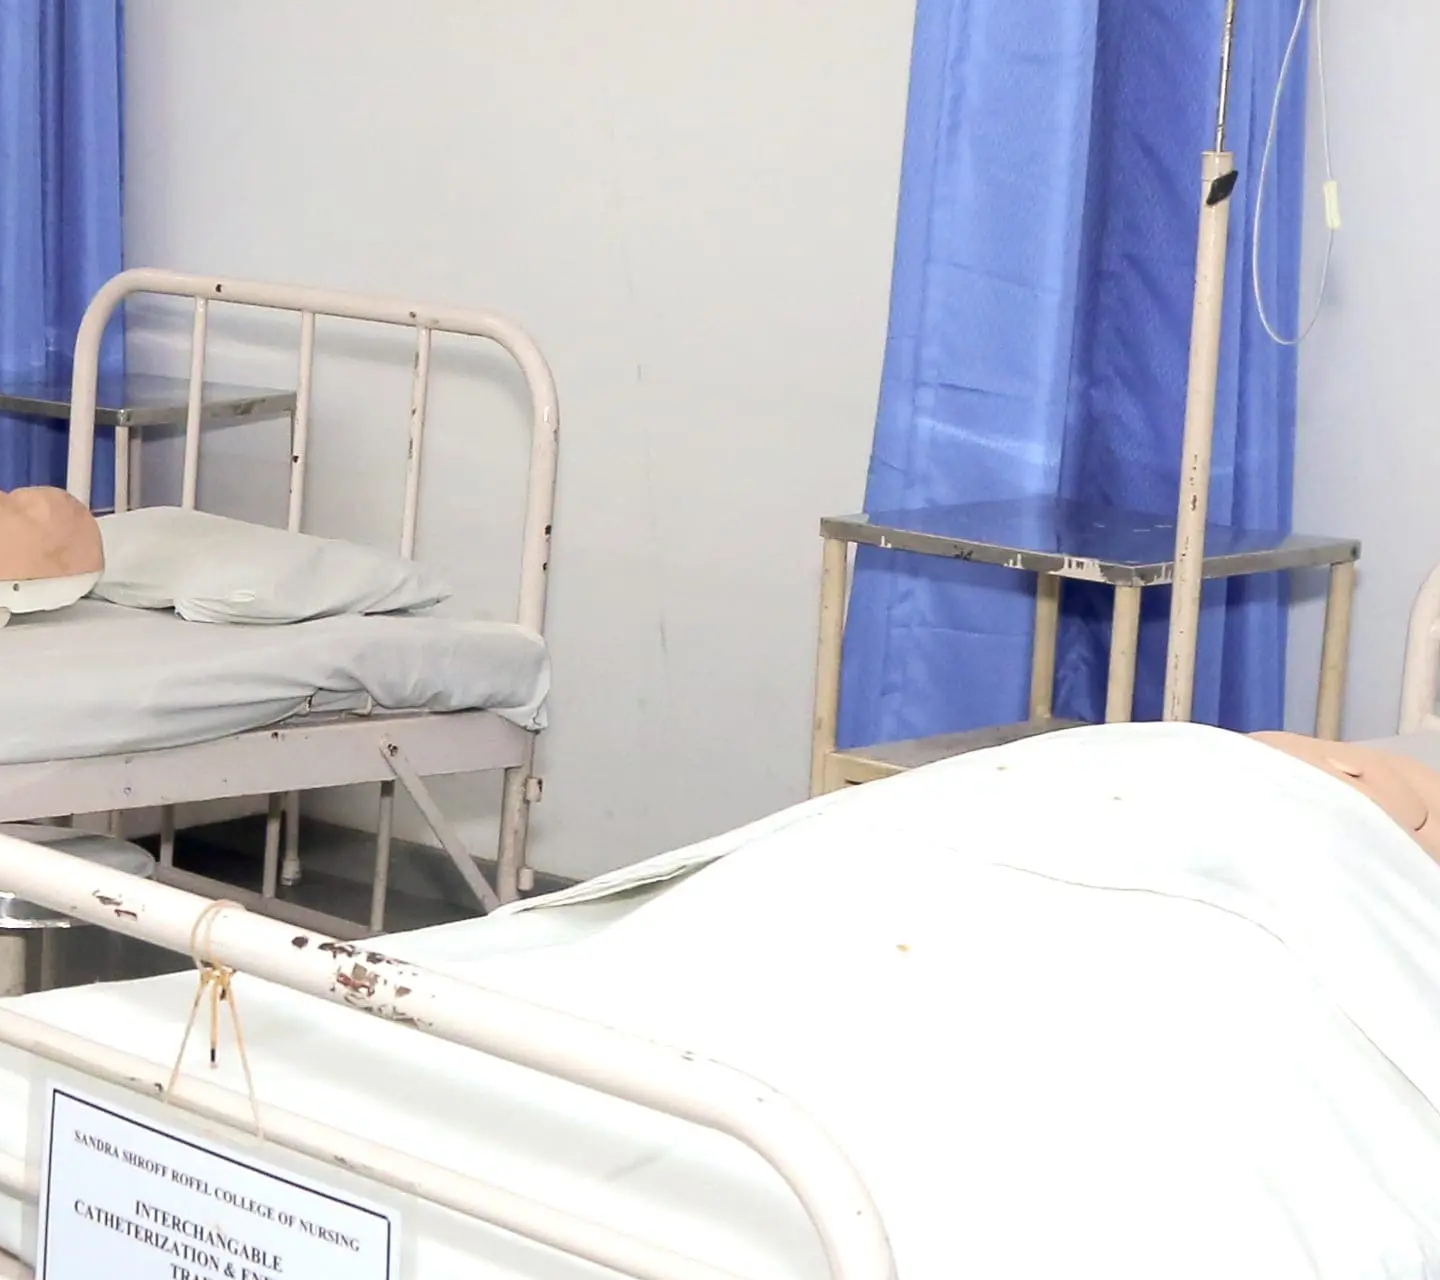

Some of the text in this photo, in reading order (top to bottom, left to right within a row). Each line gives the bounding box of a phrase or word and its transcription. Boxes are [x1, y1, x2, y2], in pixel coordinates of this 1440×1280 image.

[74, 1130, 360, 1252] SANDRA SHROFF ROFEL COLLEGE OF NURSING
[74, 1199, 220, 1273] CATHETERIZATION
[224, 1261, 236, 1280] &
[135, 1199, 283, 1273] INTERCHANGABLE
